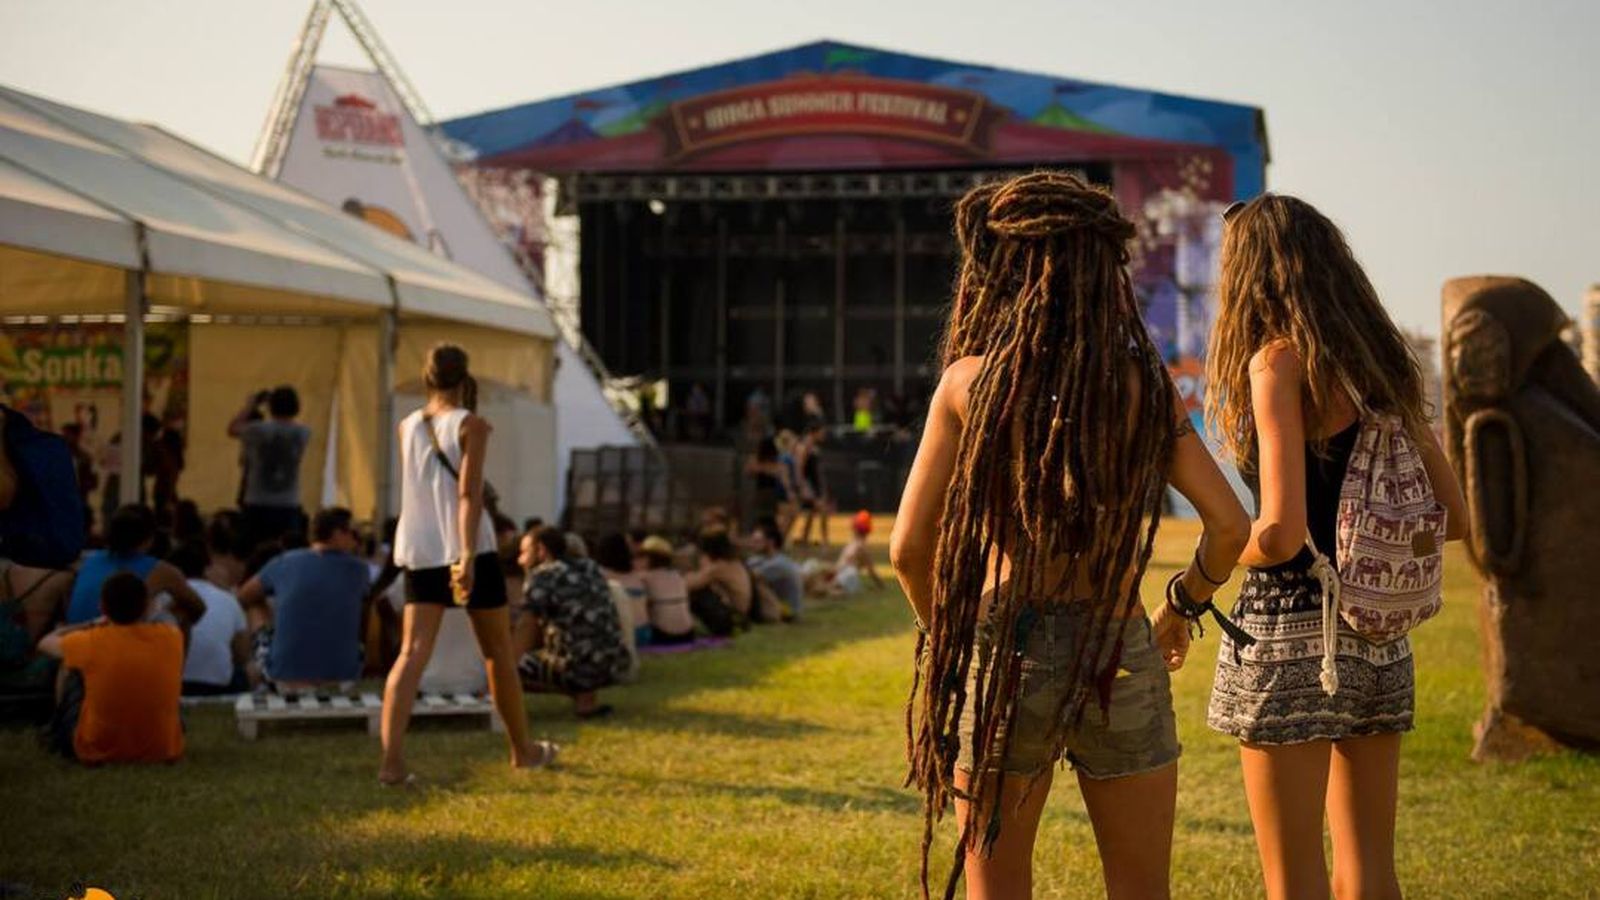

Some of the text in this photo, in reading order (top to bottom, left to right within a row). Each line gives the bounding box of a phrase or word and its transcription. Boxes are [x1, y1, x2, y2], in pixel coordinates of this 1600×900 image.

[768, 91, 854, 117] SUMMER
[857, 91, 948, 124] FESTIVAL
[23, 348, 122, 384] Sonka
